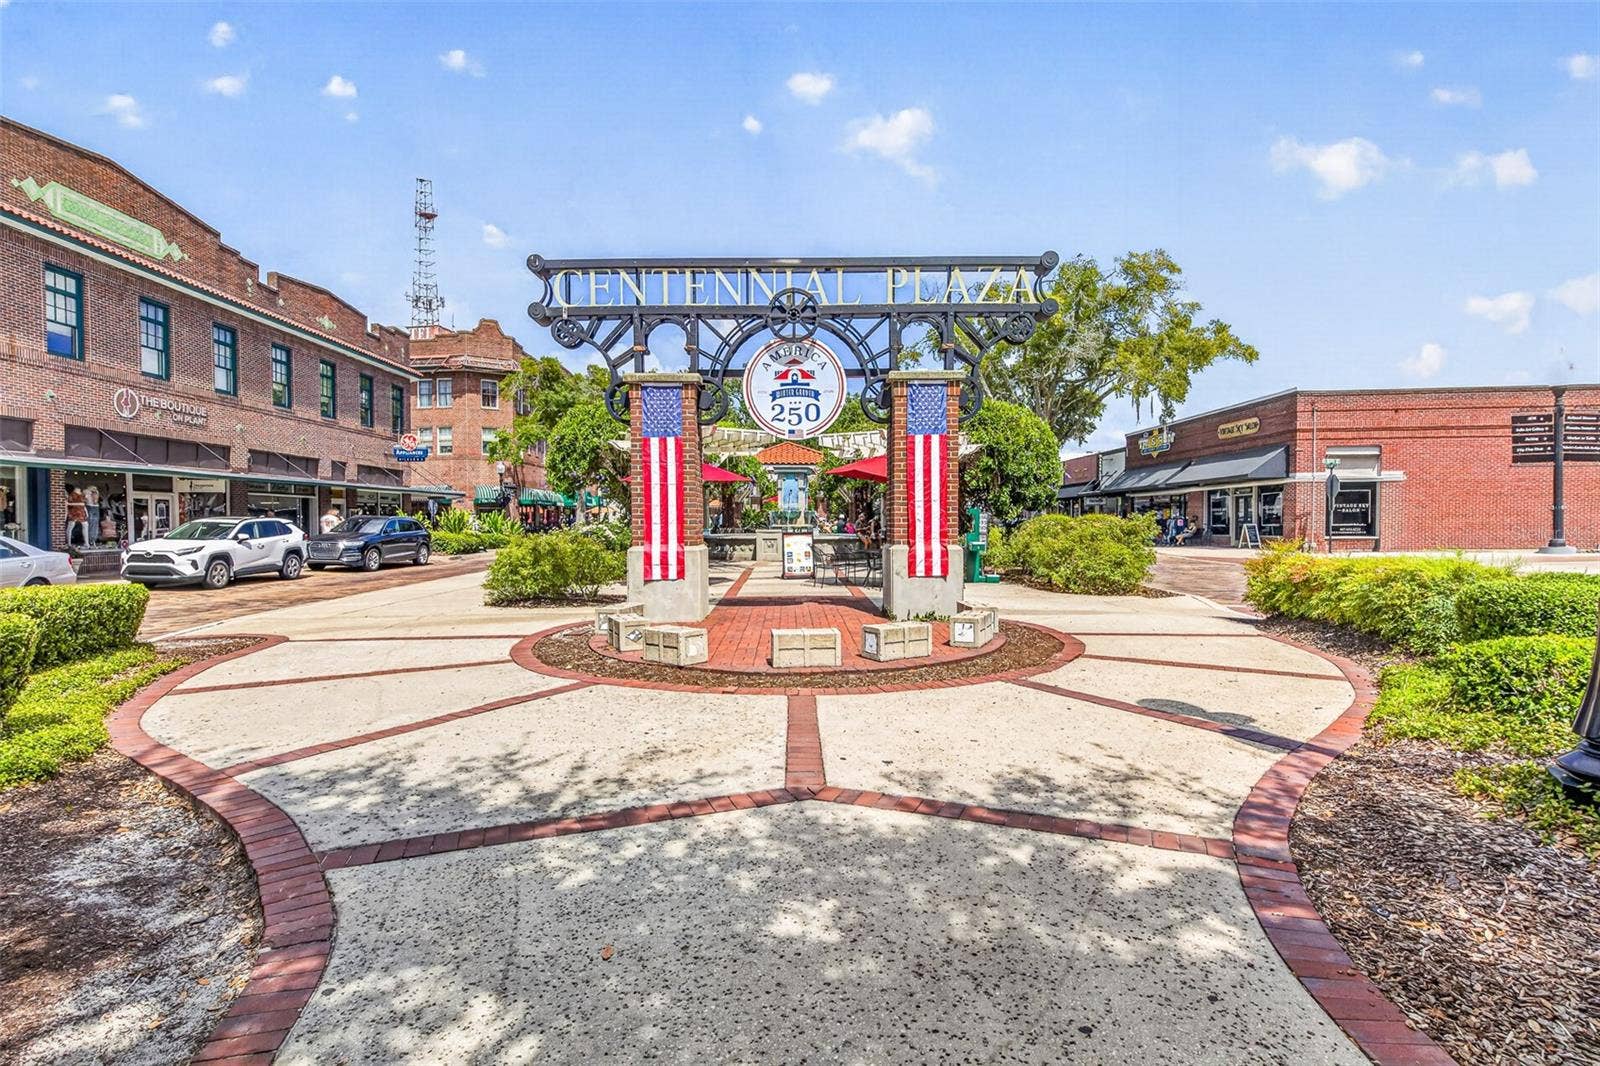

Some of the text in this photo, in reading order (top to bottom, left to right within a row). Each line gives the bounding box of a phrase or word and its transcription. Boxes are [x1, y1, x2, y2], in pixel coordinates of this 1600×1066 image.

[552, 266, 1040, 306] CENTENNIAL PLAZA
[762, 345, 827, 371] AMERICA
[140, 395, 207, 416] THE BOUTIQUE
[770, 403, 821, 426] 250
